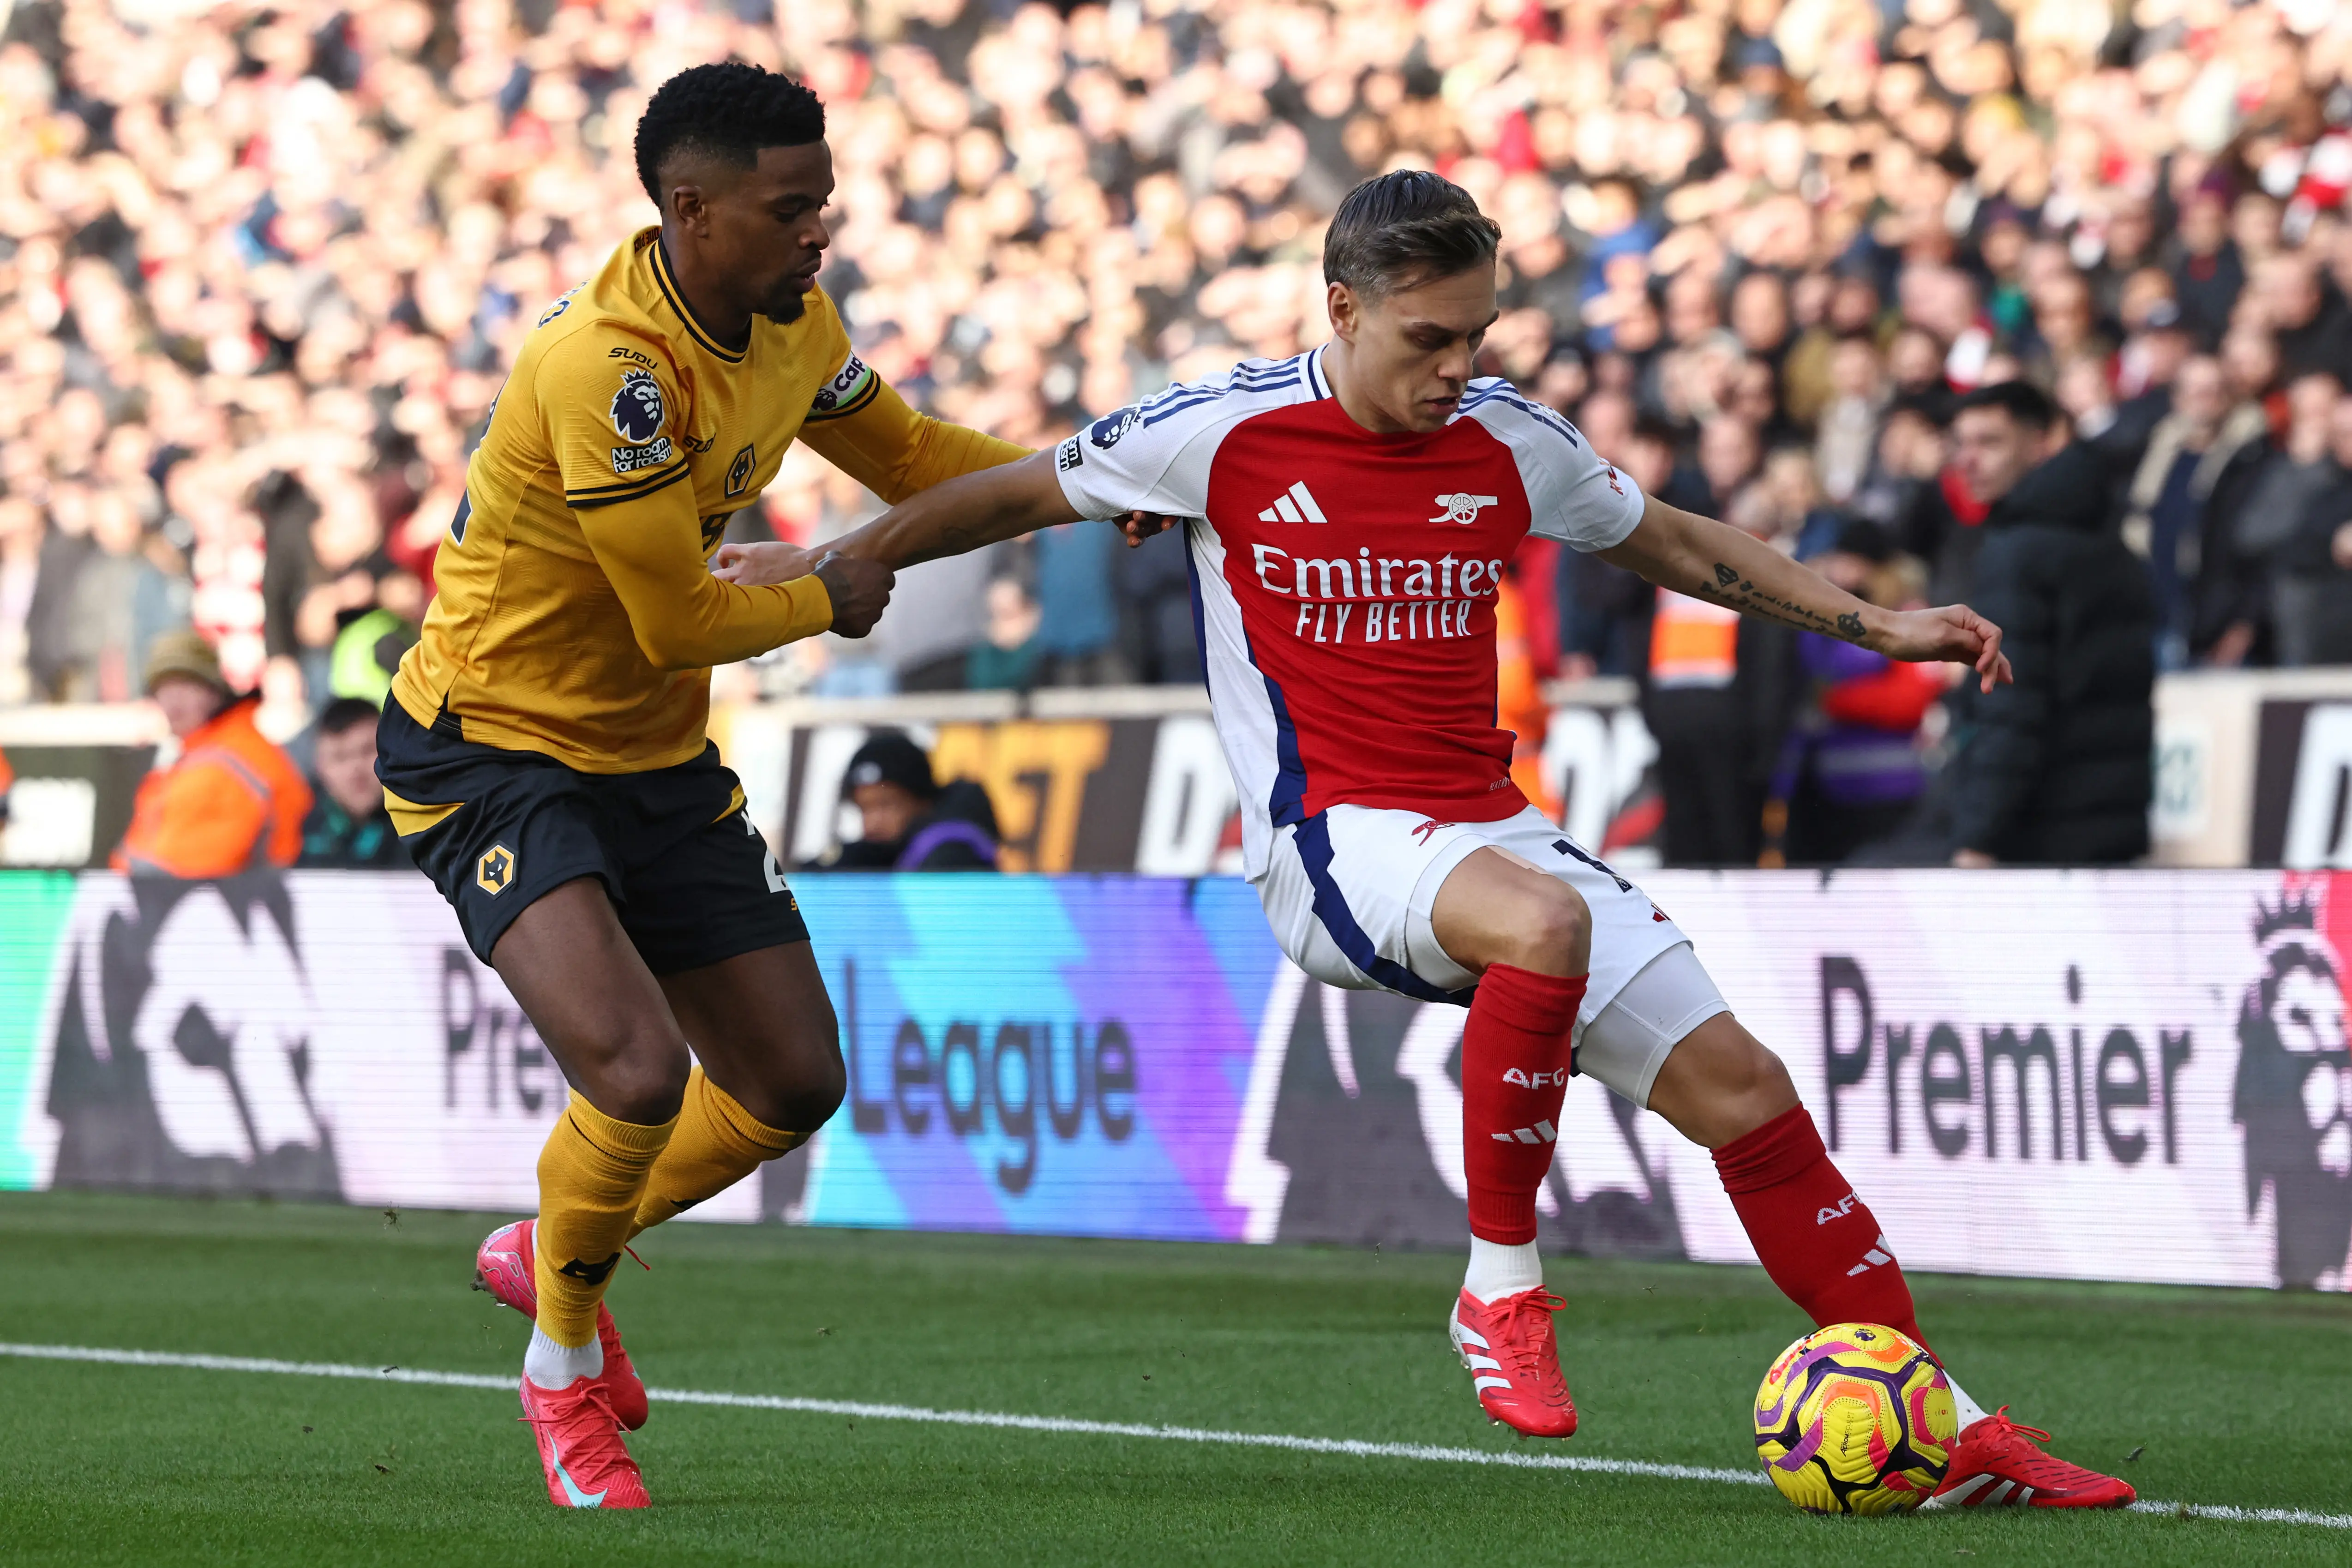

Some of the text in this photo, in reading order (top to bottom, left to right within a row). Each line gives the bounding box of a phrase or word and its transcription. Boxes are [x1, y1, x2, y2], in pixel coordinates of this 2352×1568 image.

[608, 348, 658, 369] SUDU
[612, 438, 668, 461] No room
[612, 445, 672, 473] for racism
[1251, 543, 1503, 599] Emirates
[1295, 600, 1472, 643] FLY BETTER
[843, 954, 1138, 1199] League
[1502, 1067, 1564, 1090] AFC
[1819, 954, 2193, 1168] Premier
